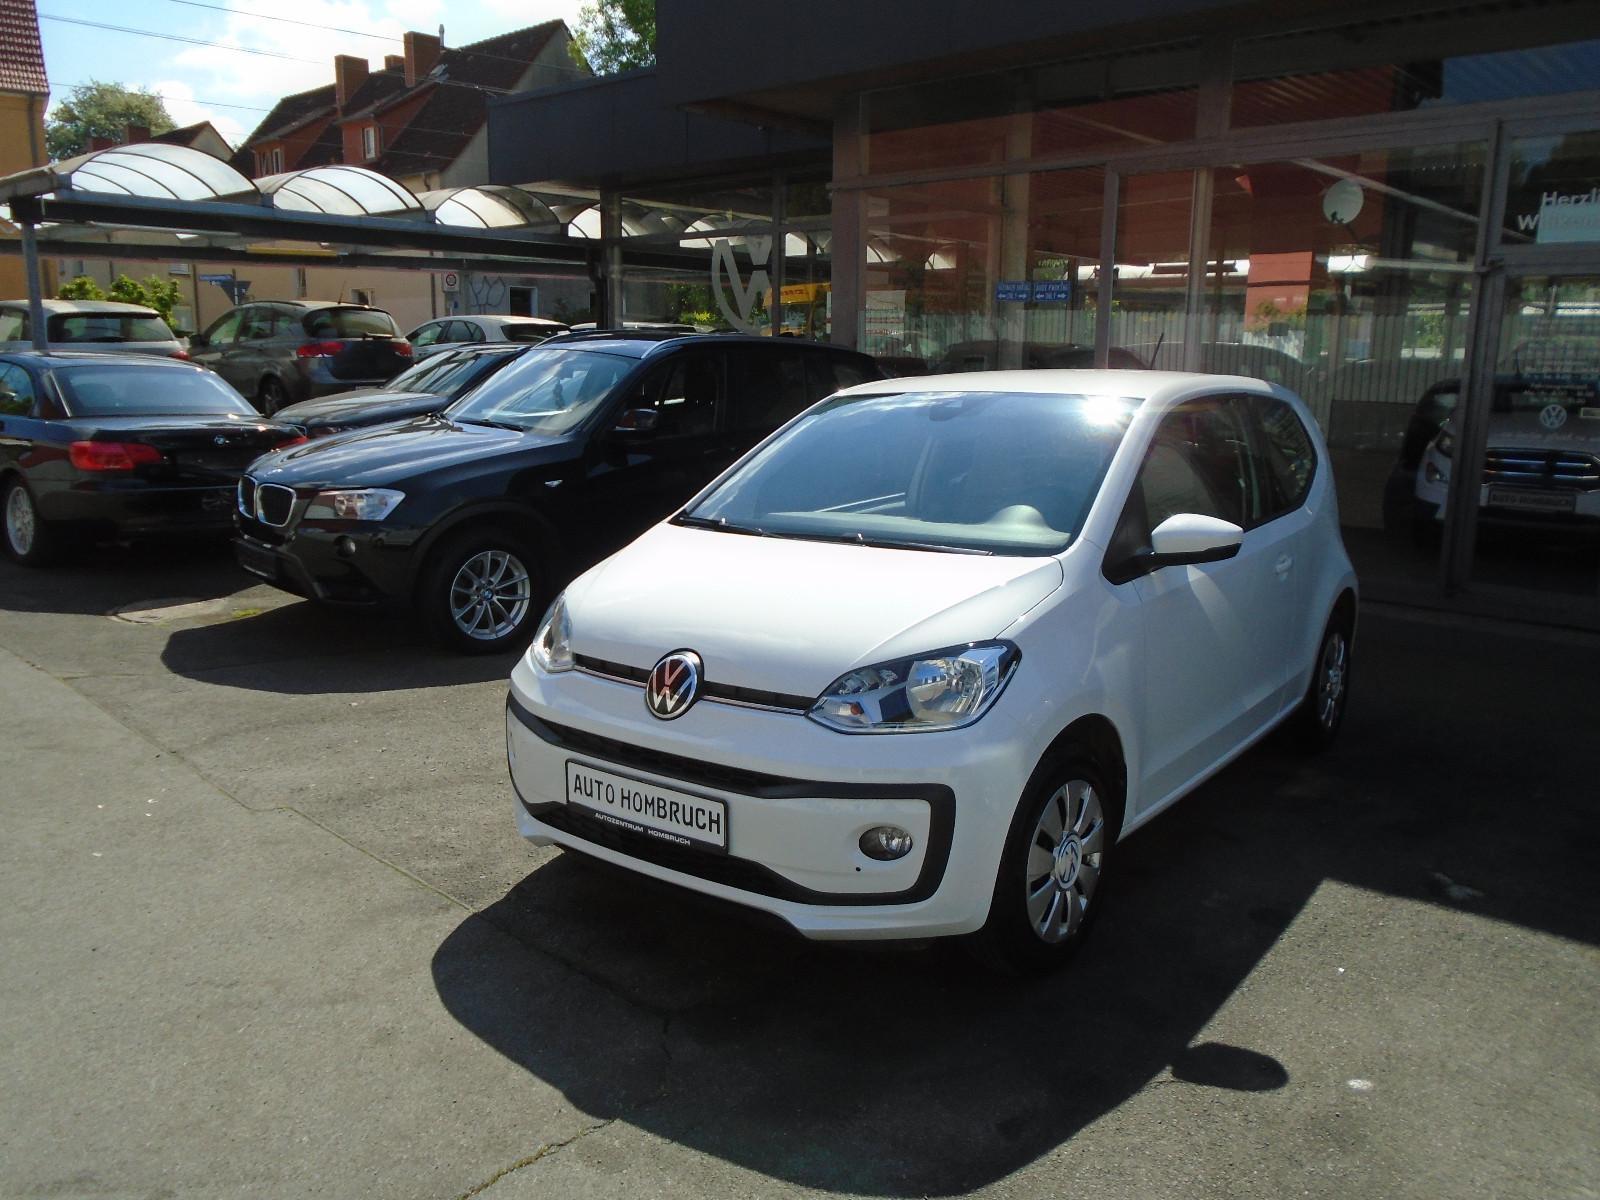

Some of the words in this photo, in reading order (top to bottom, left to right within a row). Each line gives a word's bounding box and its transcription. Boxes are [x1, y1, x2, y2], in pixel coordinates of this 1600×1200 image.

[1541, 187, 1600, 208] Herzl
[574, 773, 615, 804] AUTO
[620, 787, 721, 835] HOMBRUCH
[594, 812, 644, 833] AUTOZENTRUM
[647, 828, 691, 846] HOMBRUCH
